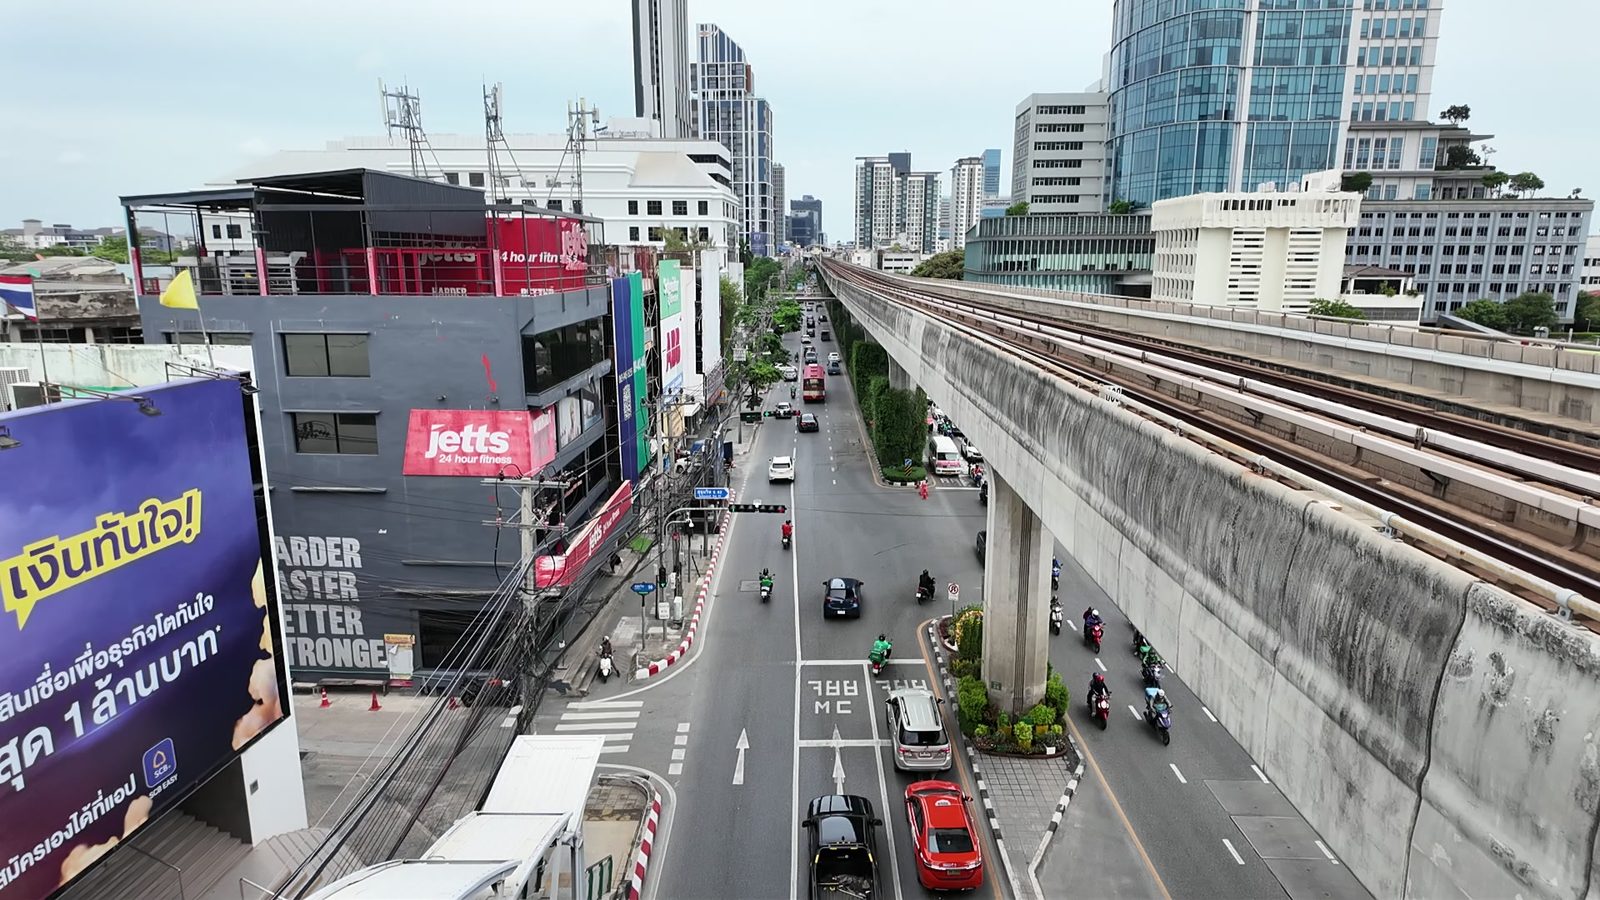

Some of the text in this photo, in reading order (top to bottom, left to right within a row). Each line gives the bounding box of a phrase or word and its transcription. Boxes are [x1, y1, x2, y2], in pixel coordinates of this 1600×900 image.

[510, 251, 537, 263] hour
[425, 424, 510, 458] jetts
[439, 454, 512, 464] 24 hour fitness
[9, 495, 193, 600] เงินทันใจ!
[274, 536, 362, 568] ARDER
[279, 570, 360, 602] ASTER
[282, 604, 364, 635] ETTER
[286, 637, 388, 668] TRONGE
[153, 764, 168, 779] SCB
